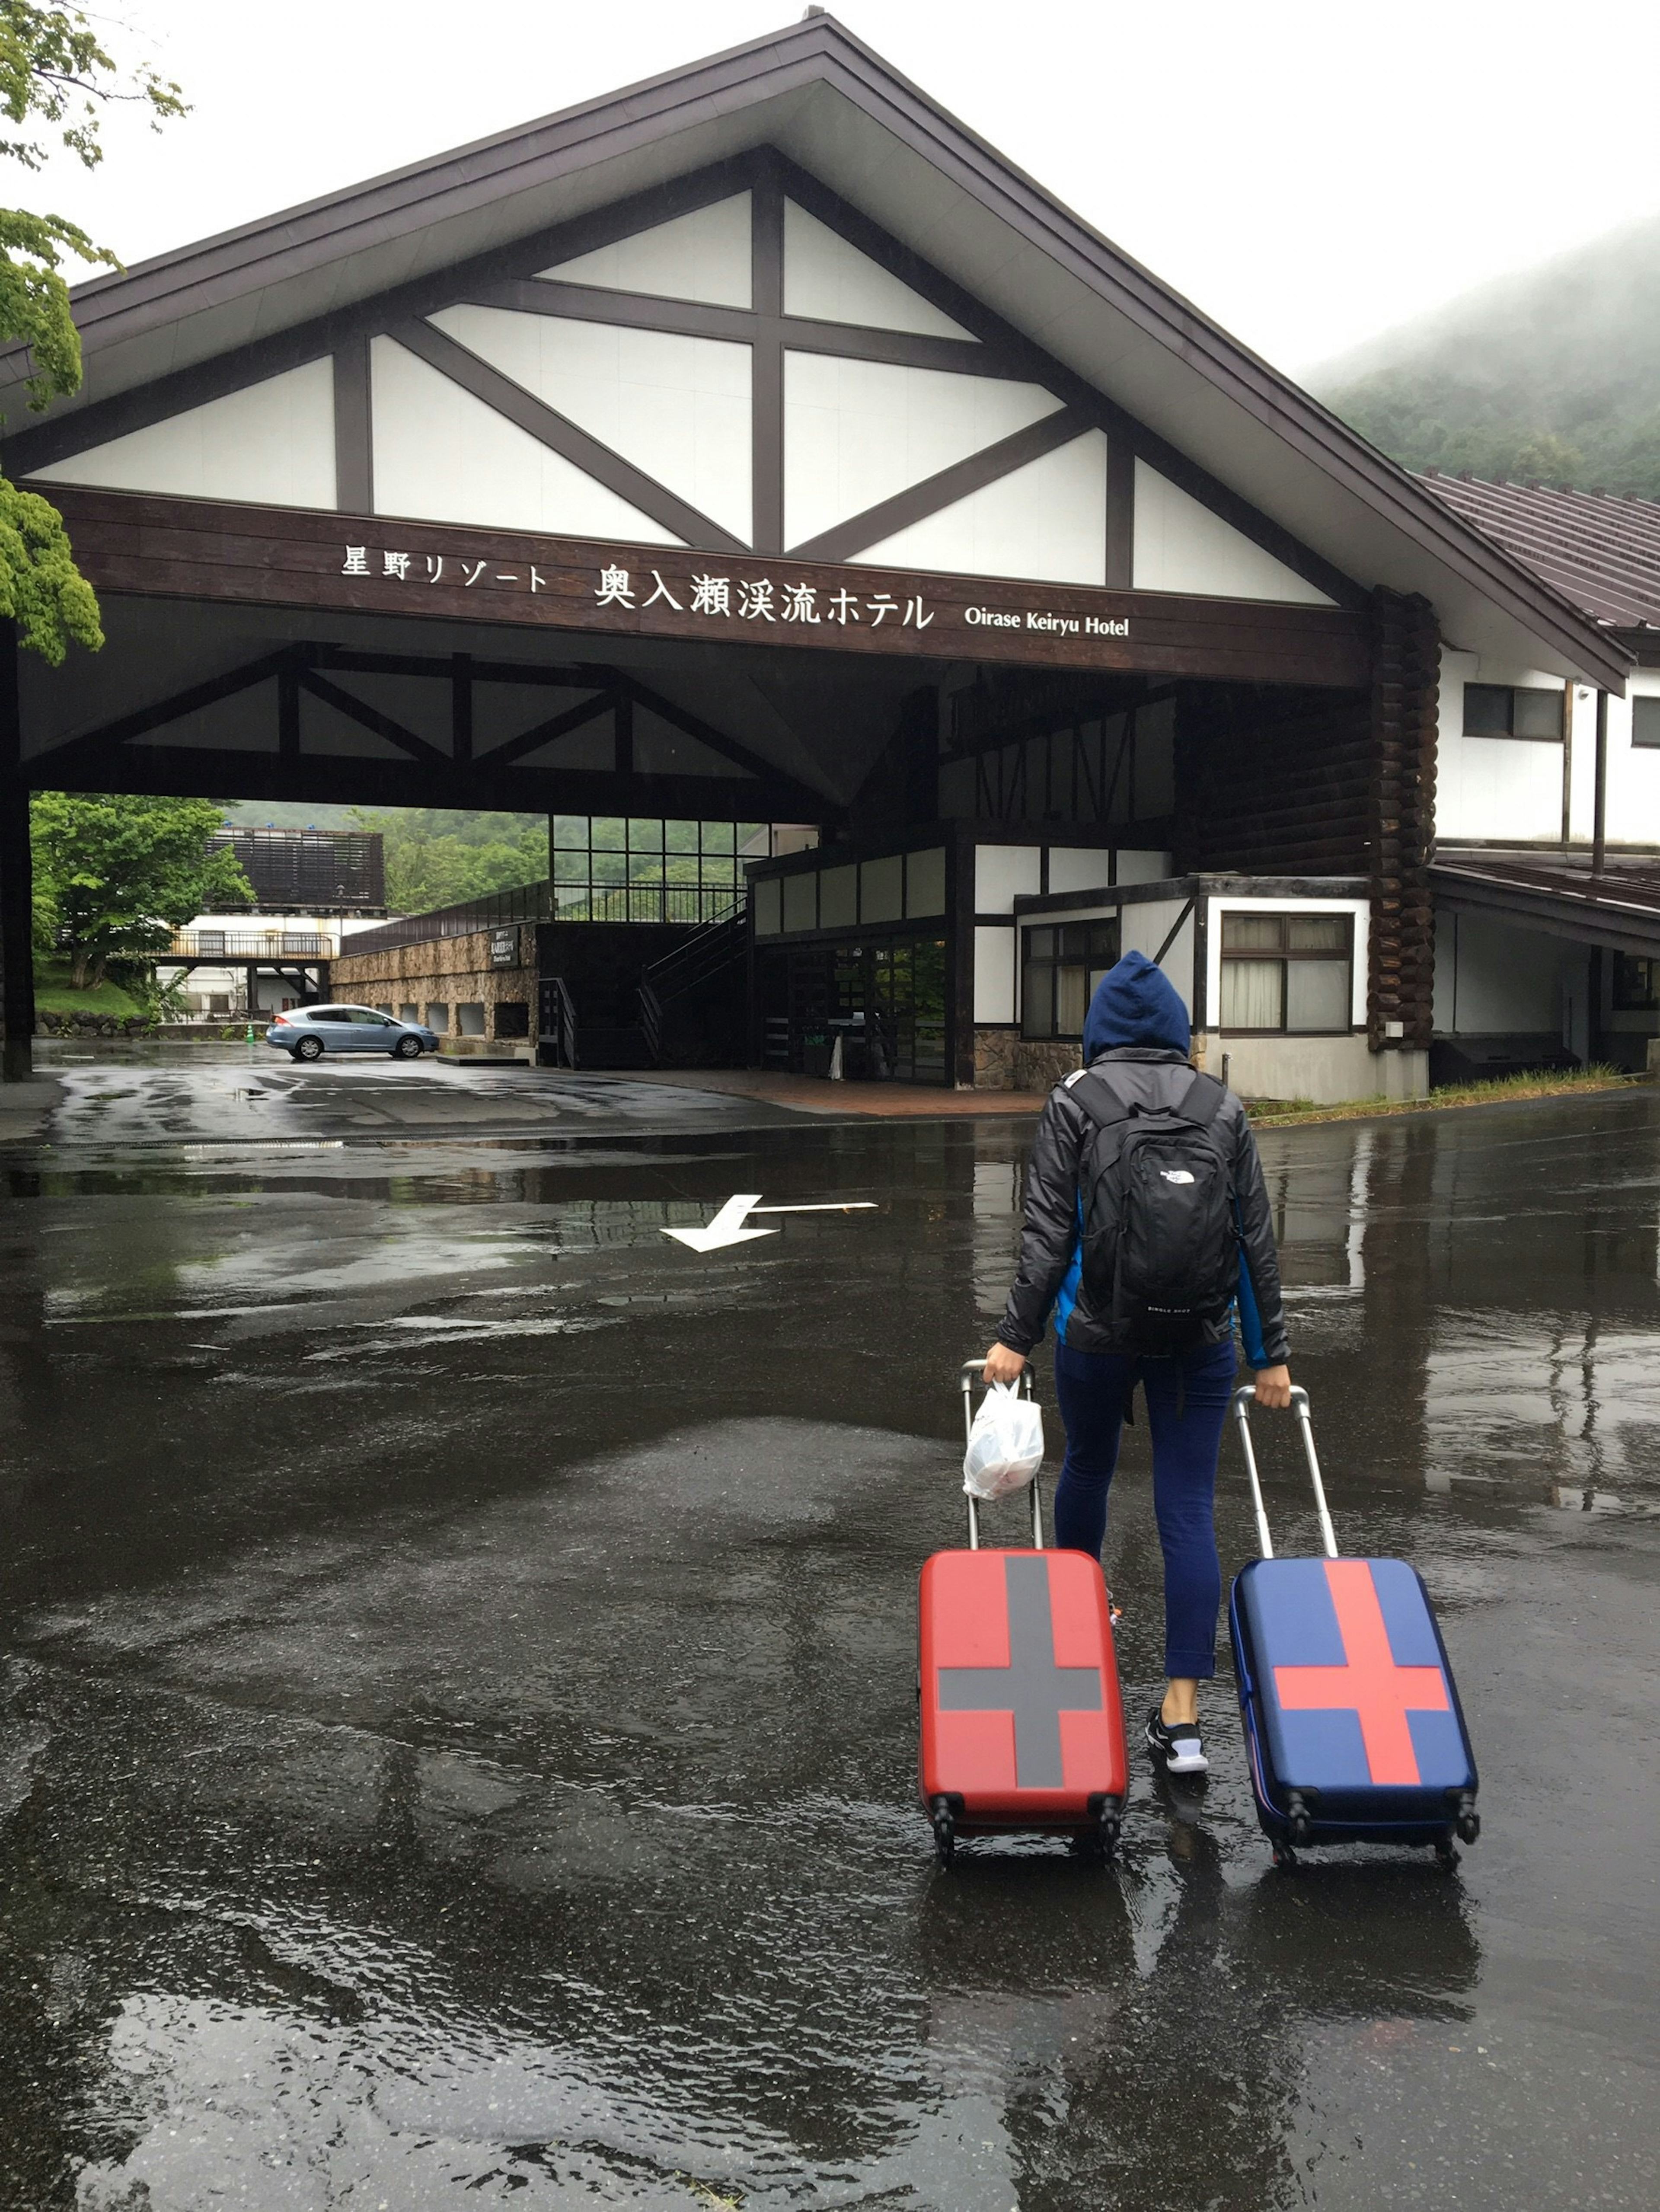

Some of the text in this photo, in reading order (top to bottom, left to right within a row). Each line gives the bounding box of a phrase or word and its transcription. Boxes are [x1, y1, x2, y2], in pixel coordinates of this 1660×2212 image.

[342, 546, 935, 629] 星野リゾート 奥入瀬渓流ホテル
[964, 607, 1129, 636] Oirase Keiryu Hotel
